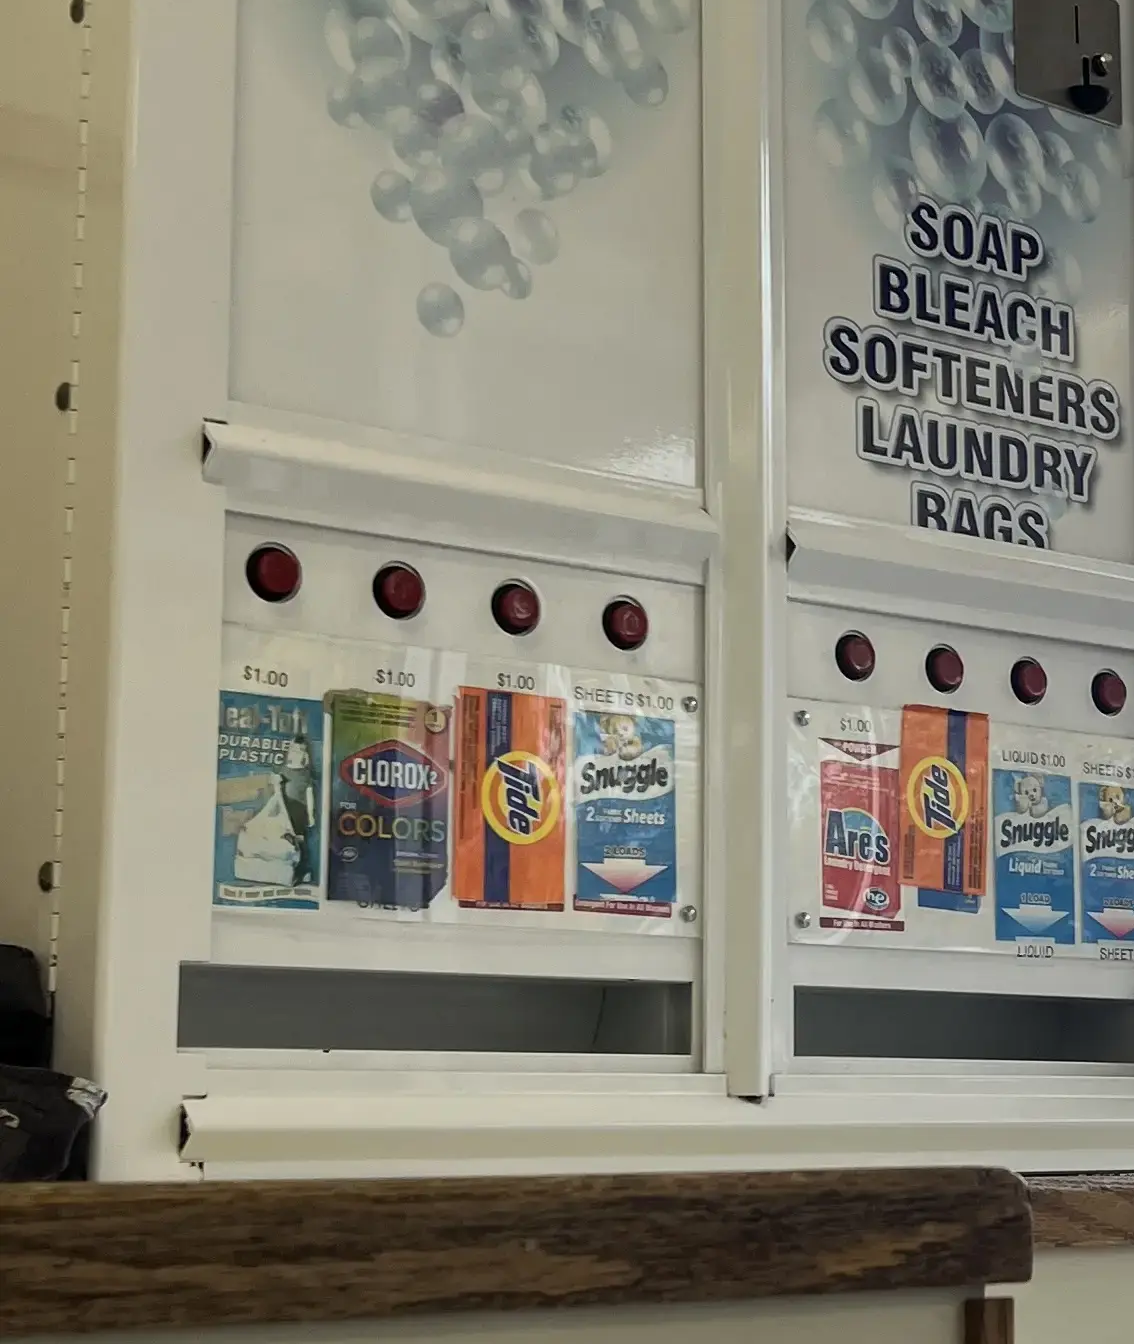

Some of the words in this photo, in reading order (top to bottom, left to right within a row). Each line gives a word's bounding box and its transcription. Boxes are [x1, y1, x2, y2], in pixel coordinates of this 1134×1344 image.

[905, 195, 1043, 281] SOAP
[874, 256, 1075, 362] BLEACH
[824, 317, 1120, 439] SOFTENERS
[857, 397, 1097, 502] LAUNDRY
[243, 665, 289, 688] $1.00
[375, 669, 416, 688] $1.00
[497, 672, 536, 691] $1.00
[574, 686, 634, 706] SHEETS
[636, 693, 675, 711] $1.00
[840, 718, 872, 733] $1.00
[218, 734, 290, 752] DURABLE
[218, 748, 284, 765] PLASTIC
[1002, 750, 1038, 764] LIQUID
[1040, 753, 1066, 767] $1.00
[580, 758, 669, 794] Snuggle
[1082, 762, 1124, 778] SHEETS
[496, 757, 543, 836] Tide
[923, 764, 957, 834] Tide
[339, 812, 445, 842] COLORS
[585, 806, 595, 822] 2
[623, 808, 665, 825] Sheets
[825, 809, 890, 864] Ares
[1000, 817, 1069, 848] Snuggle
[1009, 857, 1042, 876] Liquid
[1089, 864, 1097, 877] 2
[1017, 945, 1054, 959] LIQUID
